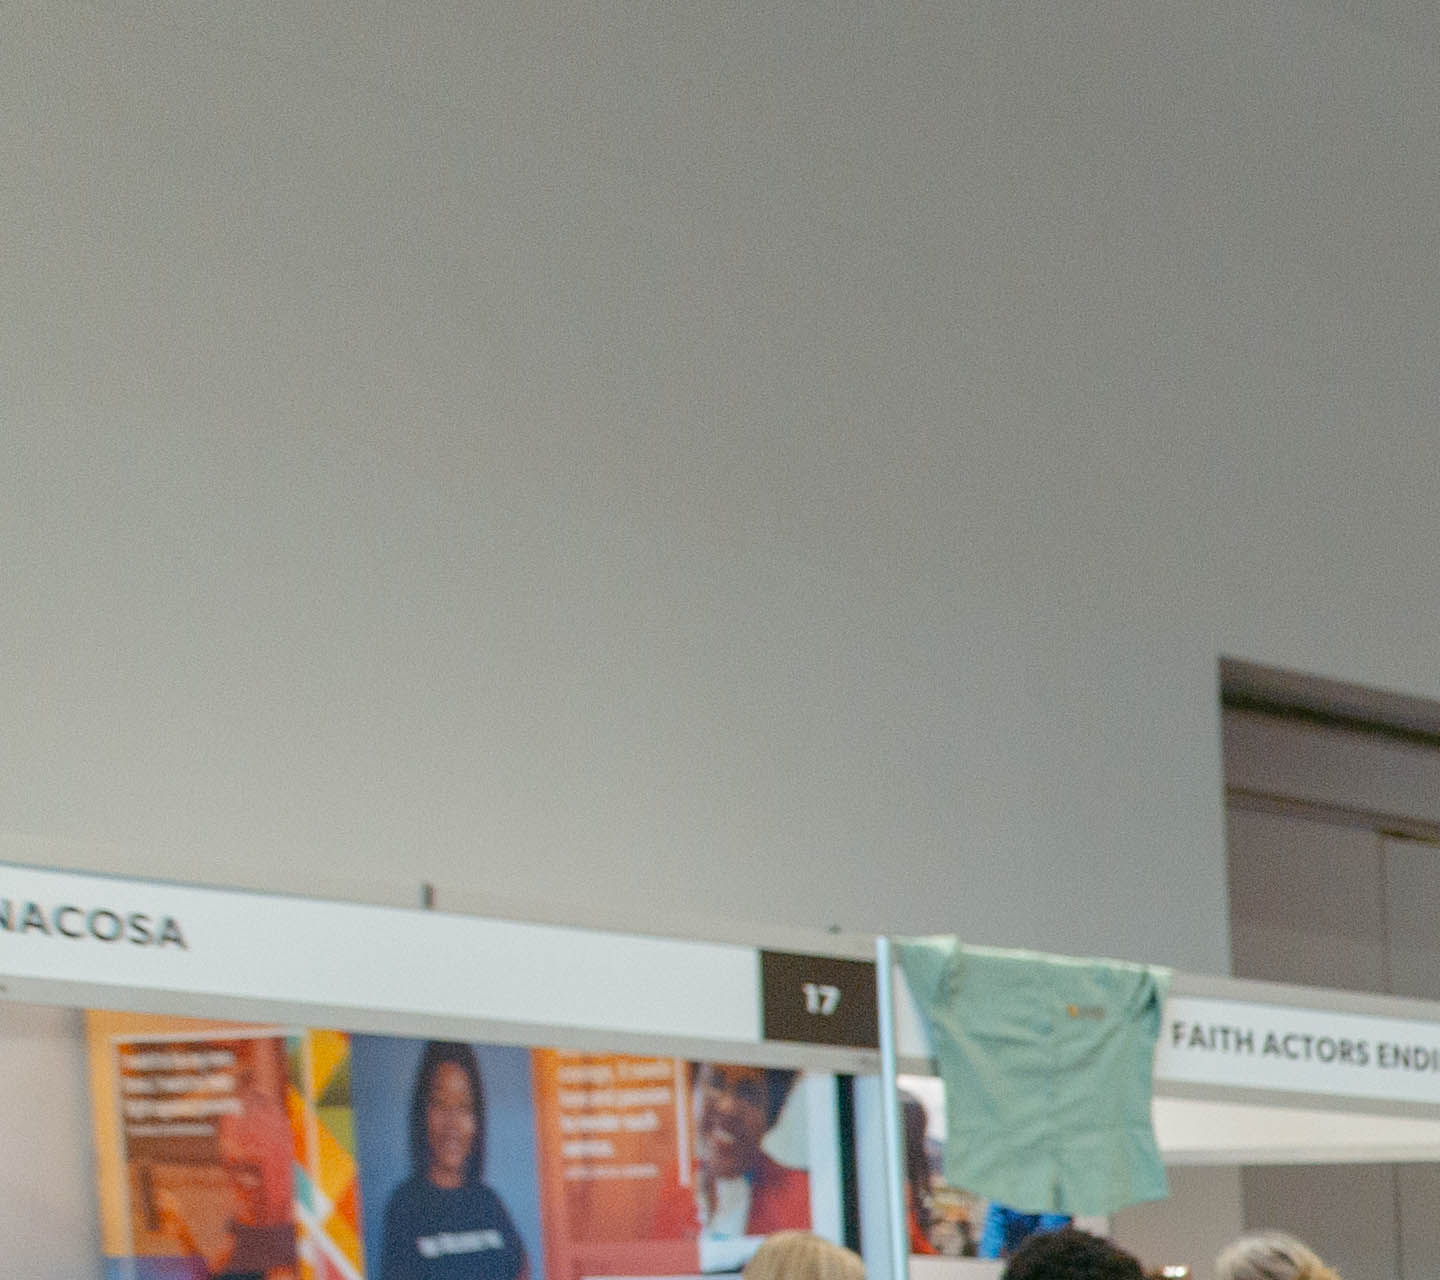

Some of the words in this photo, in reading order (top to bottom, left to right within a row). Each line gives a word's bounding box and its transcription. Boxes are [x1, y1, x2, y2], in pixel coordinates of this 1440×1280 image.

[802, 982, 842, 1016] 17
[1171, 1021, 1254, 1054] FAITH
[1263, 1034, 1369, 1066] ACTORS
